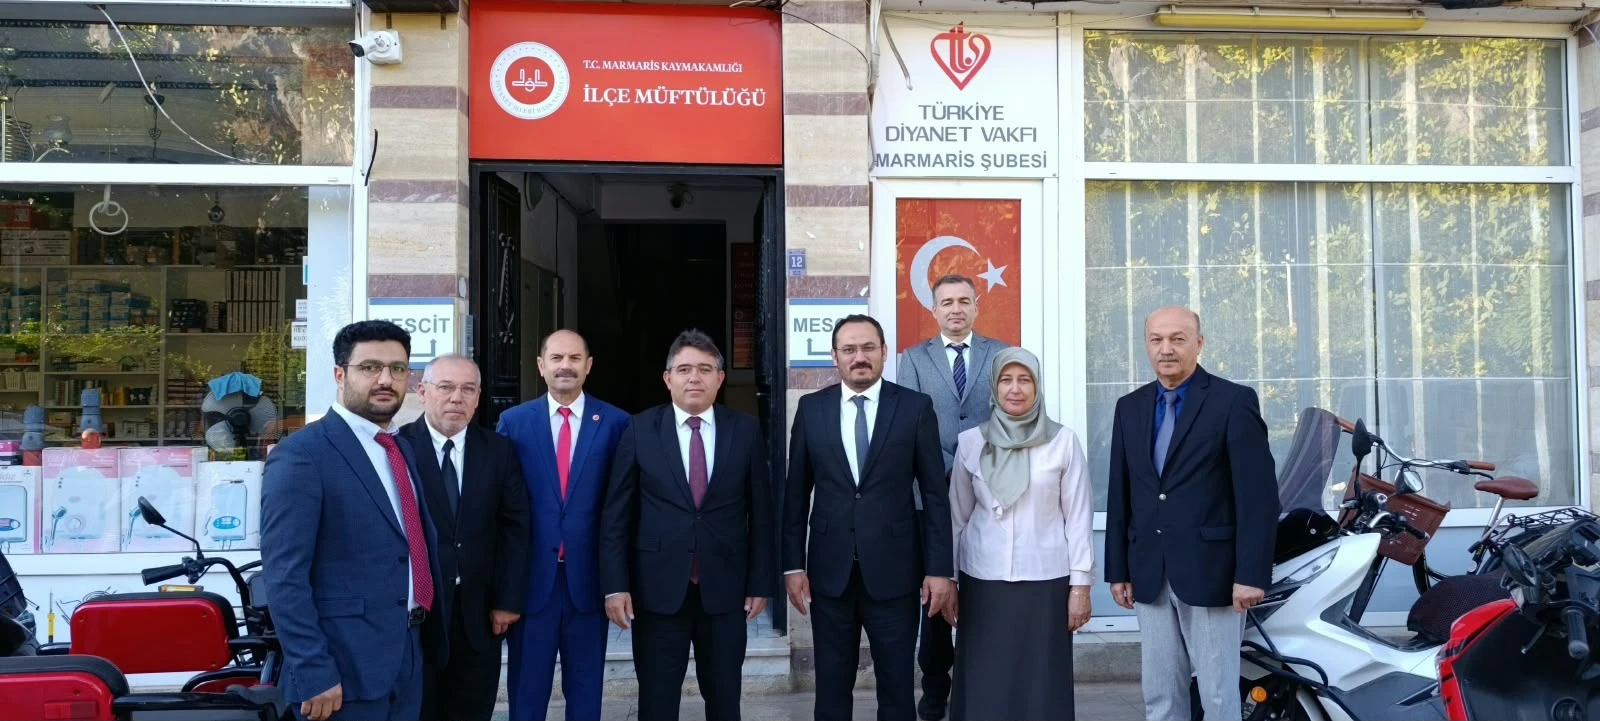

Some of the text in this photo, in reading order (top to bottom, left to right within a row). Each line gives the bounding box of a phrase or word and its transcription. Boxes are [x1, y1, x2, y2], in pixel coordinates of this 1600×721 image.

[583, 60, 743, 73] T.C. MARMARİS KAYMAKAMLIĞI
[583, 84, 767, 107] İLÇE MÜFTÜLÜĞÜ
[918, 101, 1004, 121] TÜRKİYE
[885, 123, 1037, 142] DİYANET VAKFI
[876, 150, 1047, 171] MARMARİS ŞUBESİ
[791, 256, 803, 268] 12
[793, 317, 844, 333] MES
